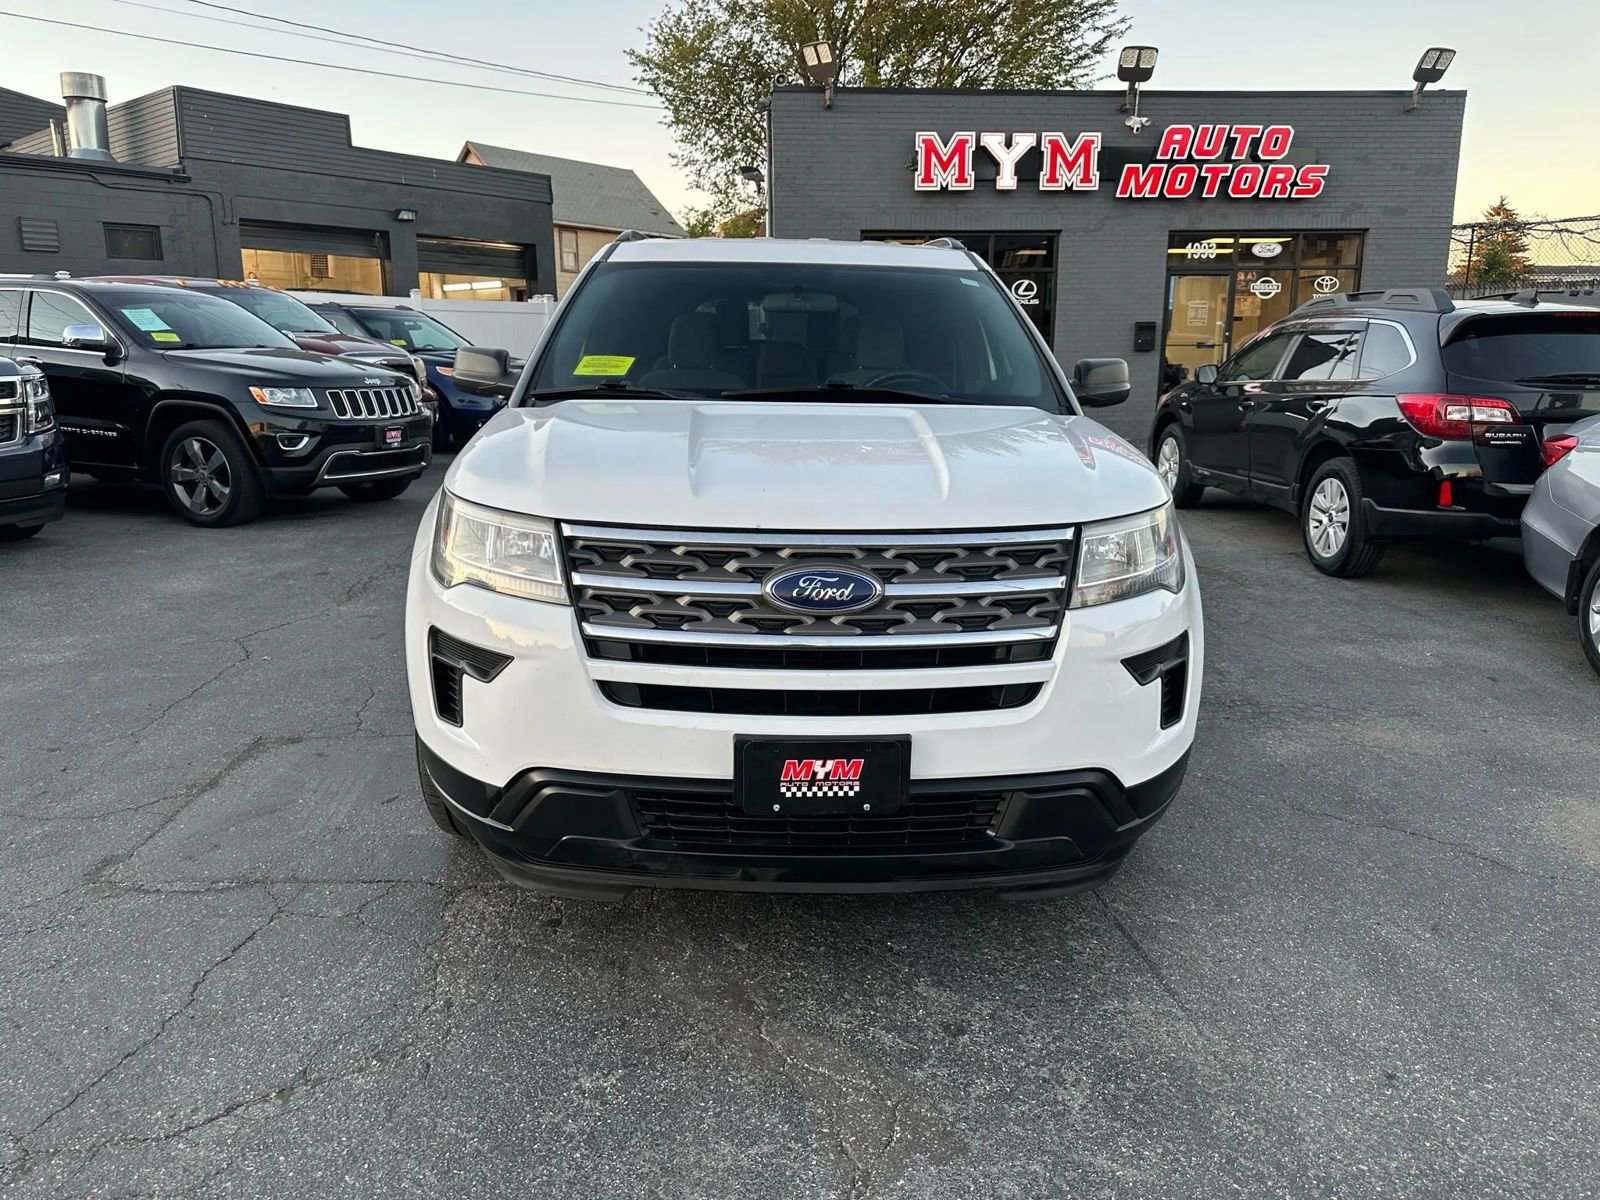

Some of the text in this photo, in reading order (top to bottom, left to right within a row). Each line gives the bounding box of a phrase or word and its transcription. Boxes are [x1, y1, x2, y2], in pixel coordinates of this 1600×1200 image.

[1156, 124, 1295, 160] AUTO
[914, 131, 1102, 192] MYM
[1115, 163, 1331, 199] MOTORS
[1185, 243, 1217, 259] 1993
[364, 377, 381, 386] Jeep
[792, 575, 855, 601] Ford
[780, 759, 864, 780] MYM
